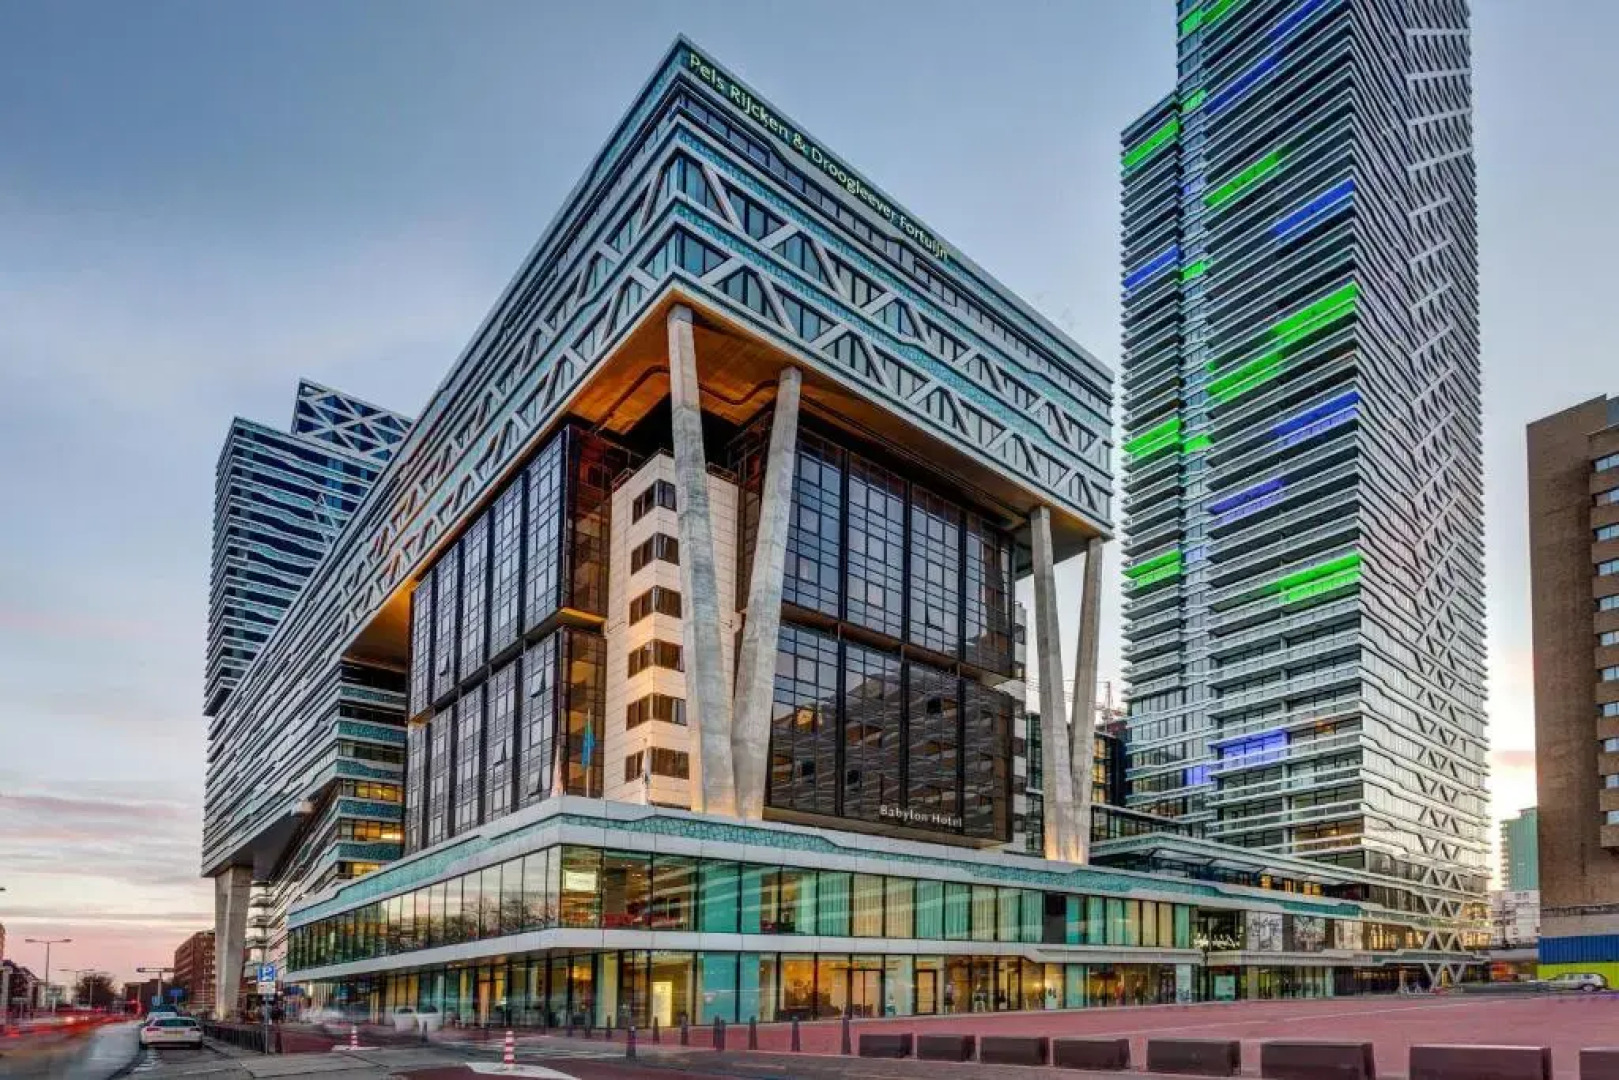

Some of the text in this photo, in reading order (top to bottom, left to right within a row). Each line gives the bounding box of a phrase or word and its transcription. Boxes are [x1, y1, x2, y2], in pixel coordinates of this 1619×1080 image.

[690, 53, 948, 260] Pels Rijcken & Droogleever Fortuijn
[880, 804, 962, 828] Babylon Hotel
